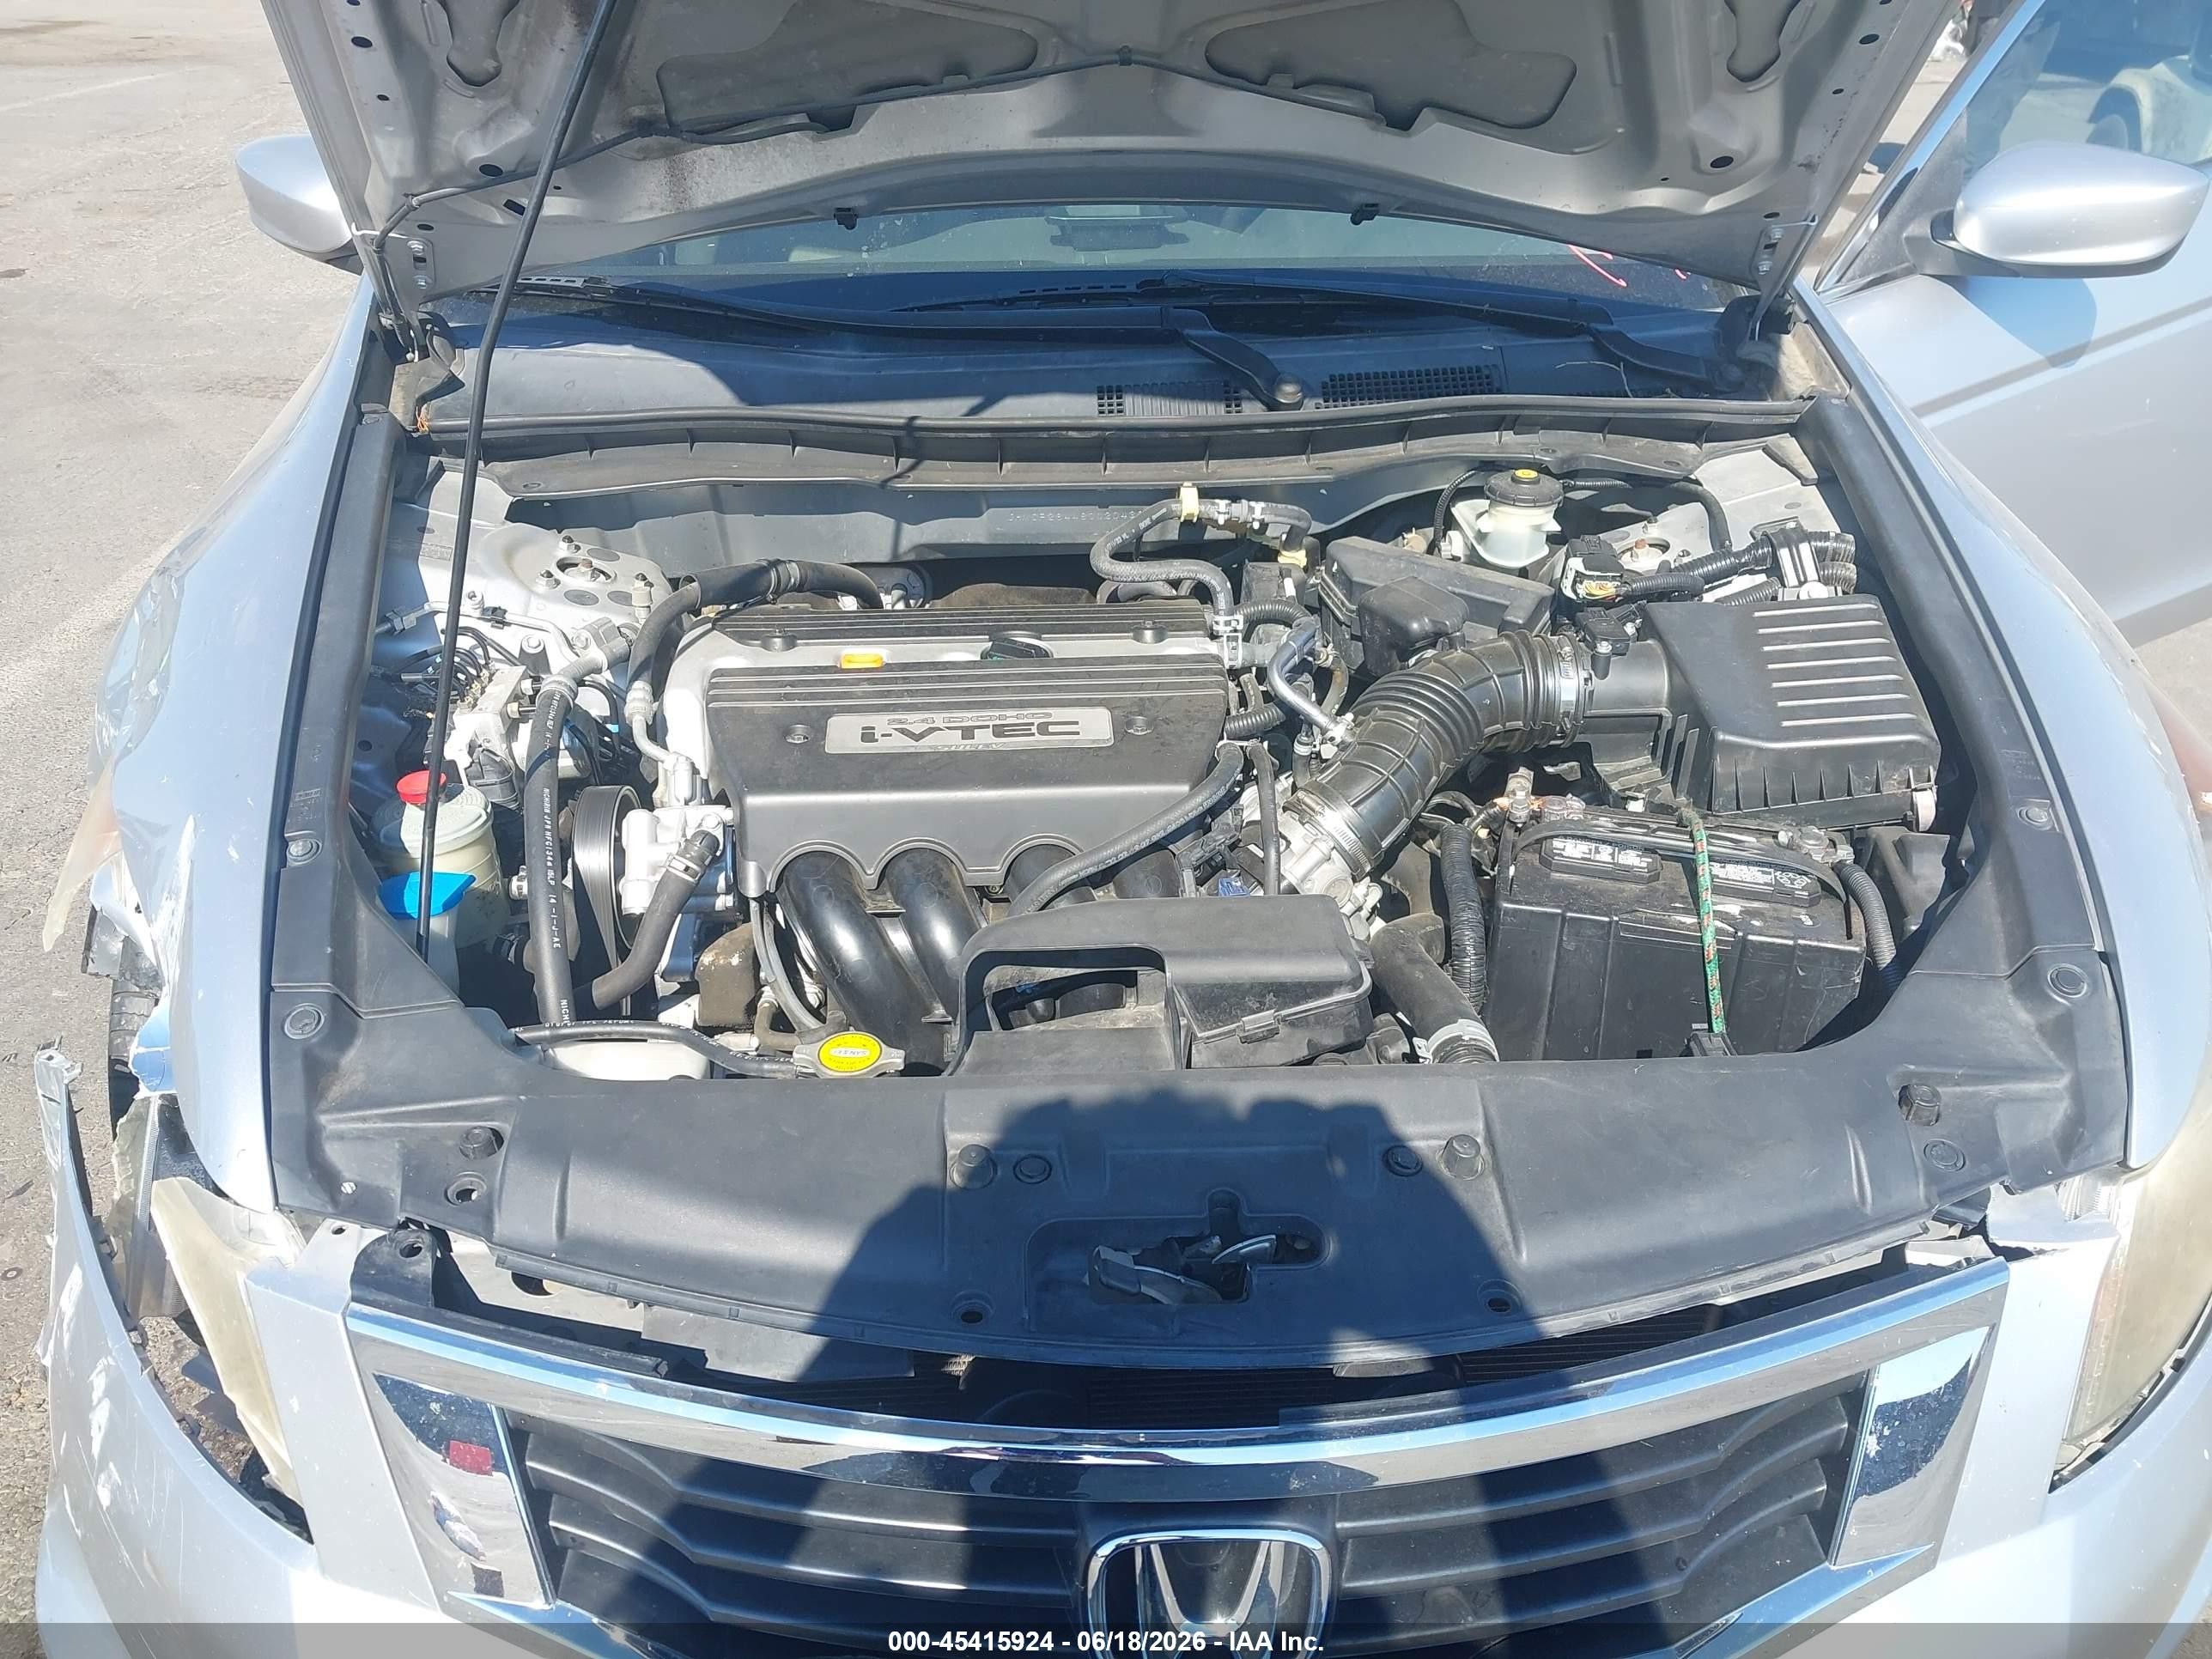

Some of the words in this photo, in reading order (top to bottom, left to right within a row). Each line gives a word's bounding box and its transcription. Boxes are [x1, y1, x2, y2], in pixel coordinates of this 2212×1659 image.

[887, 715, 936, 726] 2.4
[942, 711, 1053, 724] DOHC
[860, 720, 1080, 744] i-VTEC
